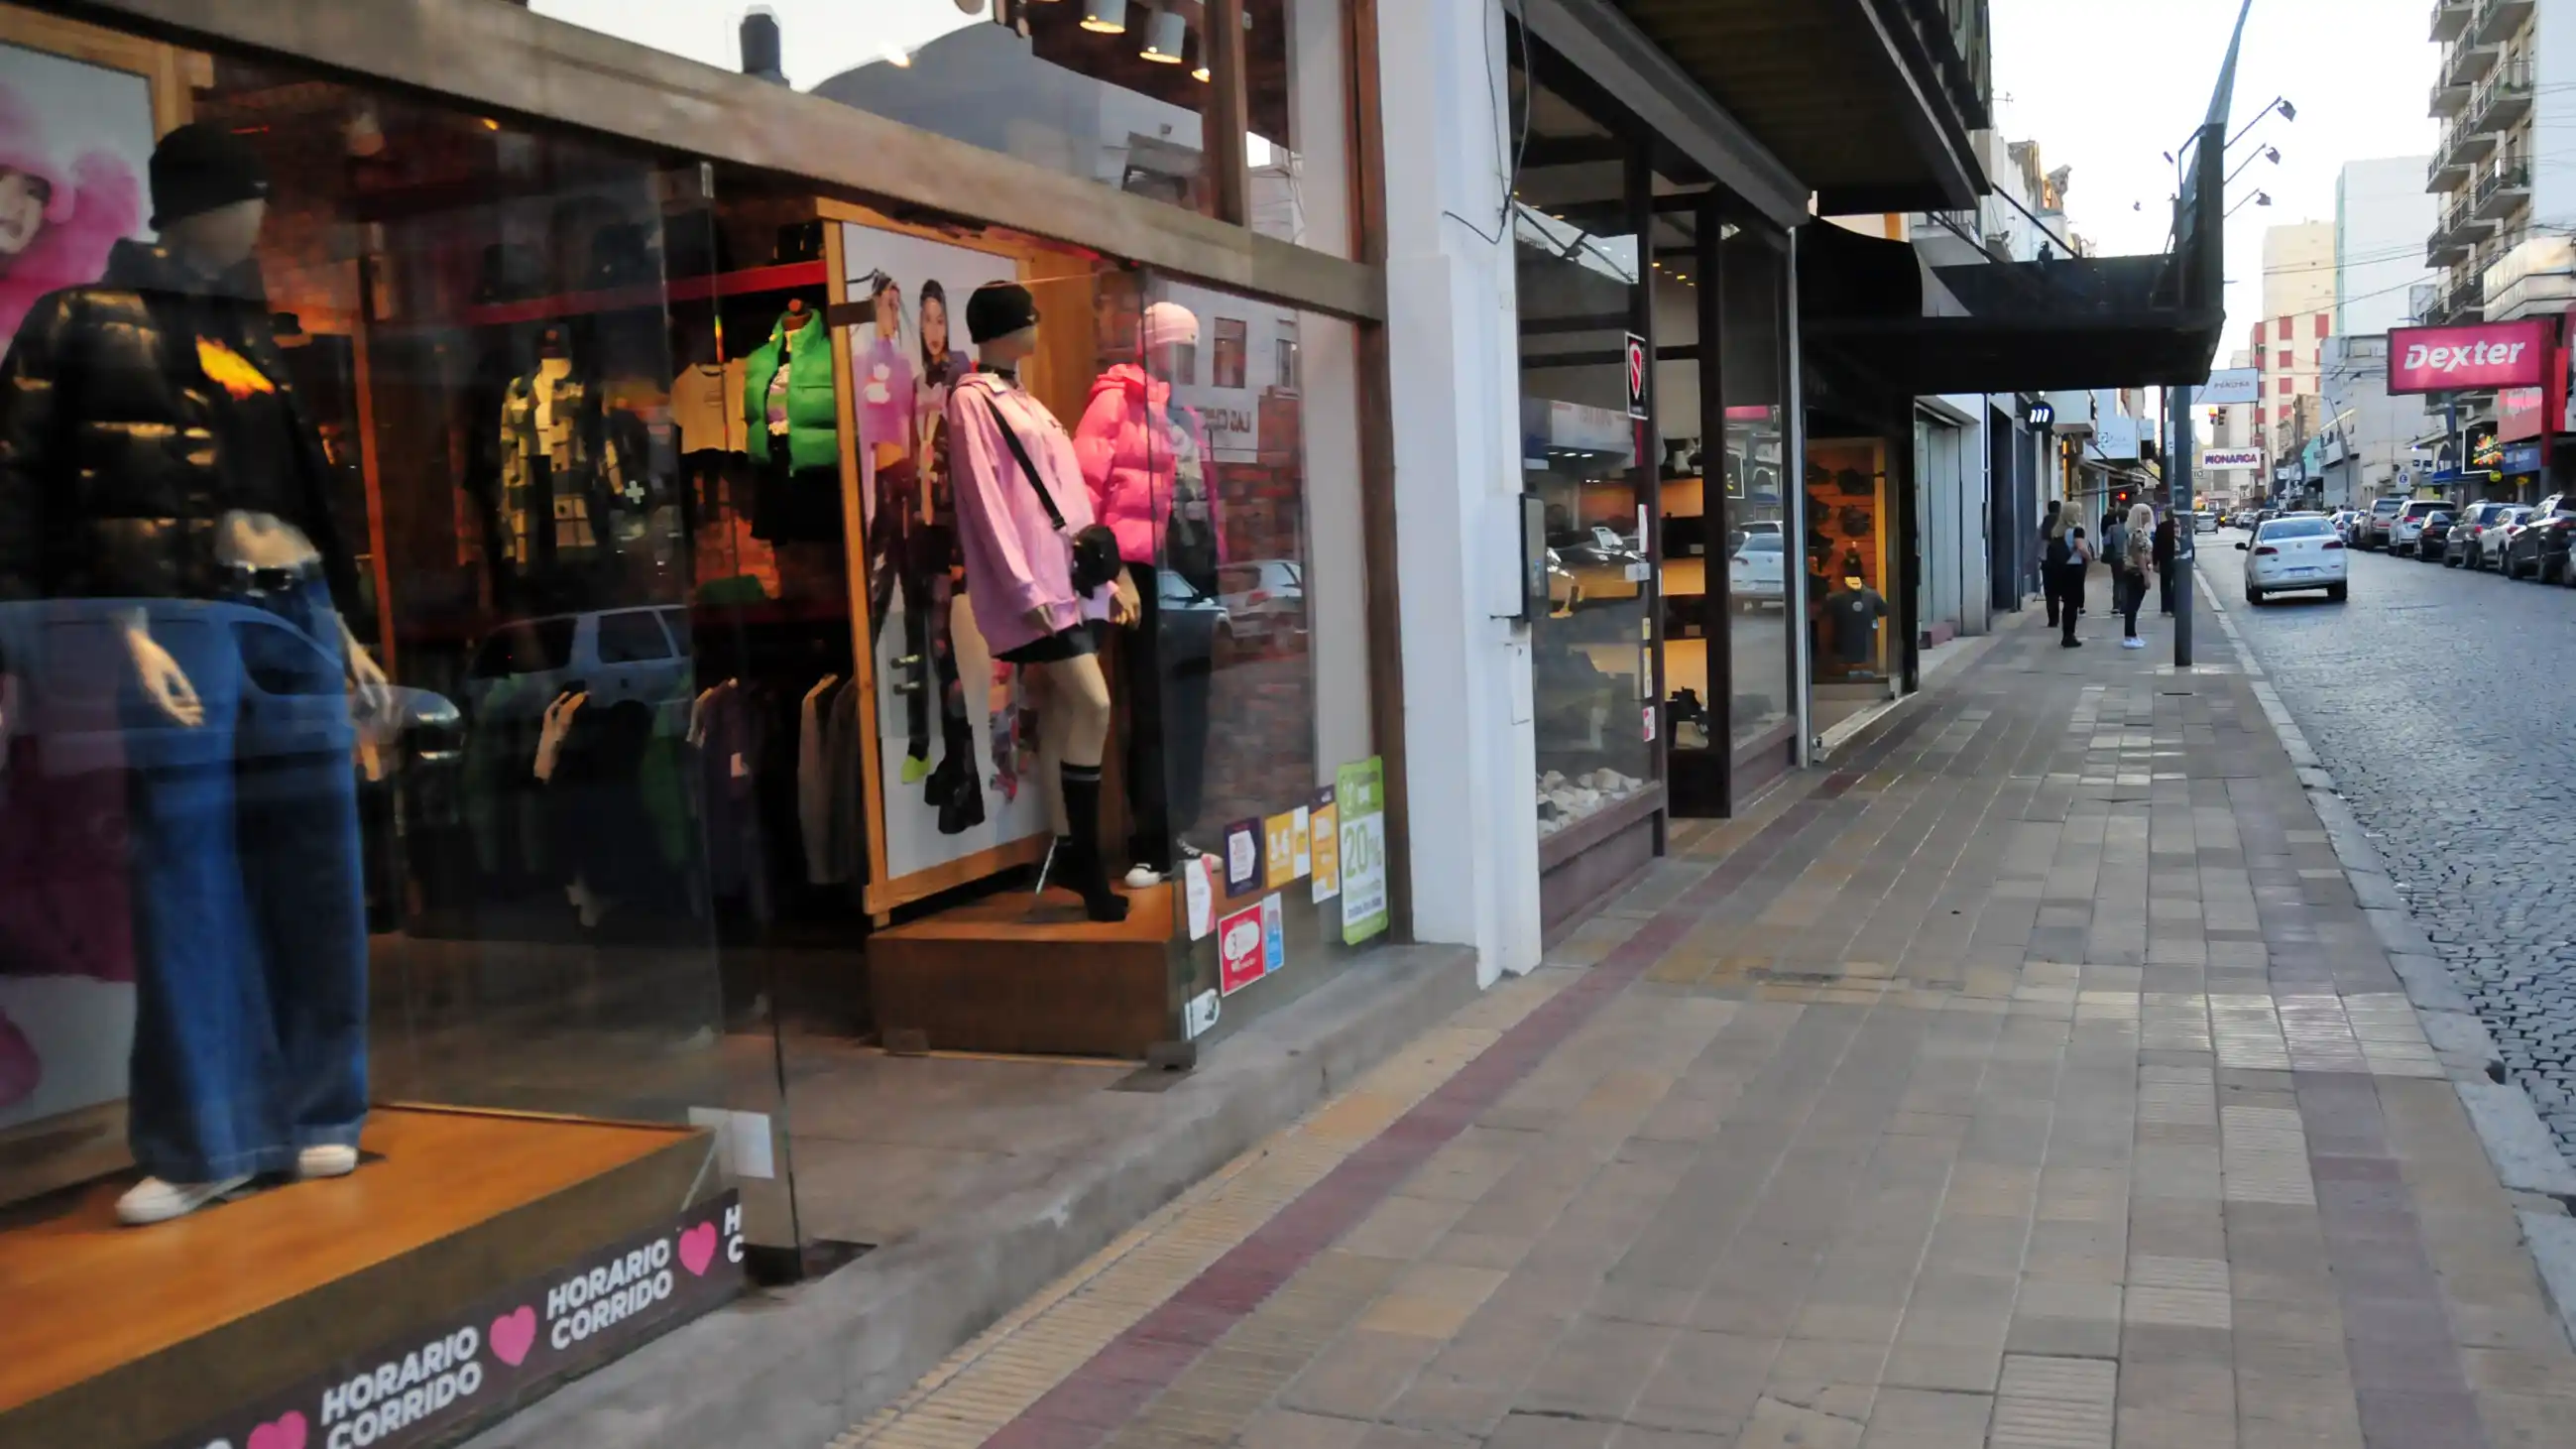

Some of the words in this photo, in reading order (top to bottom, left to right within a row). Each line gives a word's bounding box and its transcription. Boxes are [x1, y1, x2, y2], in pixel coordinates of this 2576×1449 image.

[2403, 340, 2525, 372] Dexter
[547, 1238, 670, 1320] HORARIO
[550, 1268, 673, 1350] CORRIDO
[320, 1325, 480, 1426] HORARIO
[326, 1361, 482, 1449] CORRIDO
